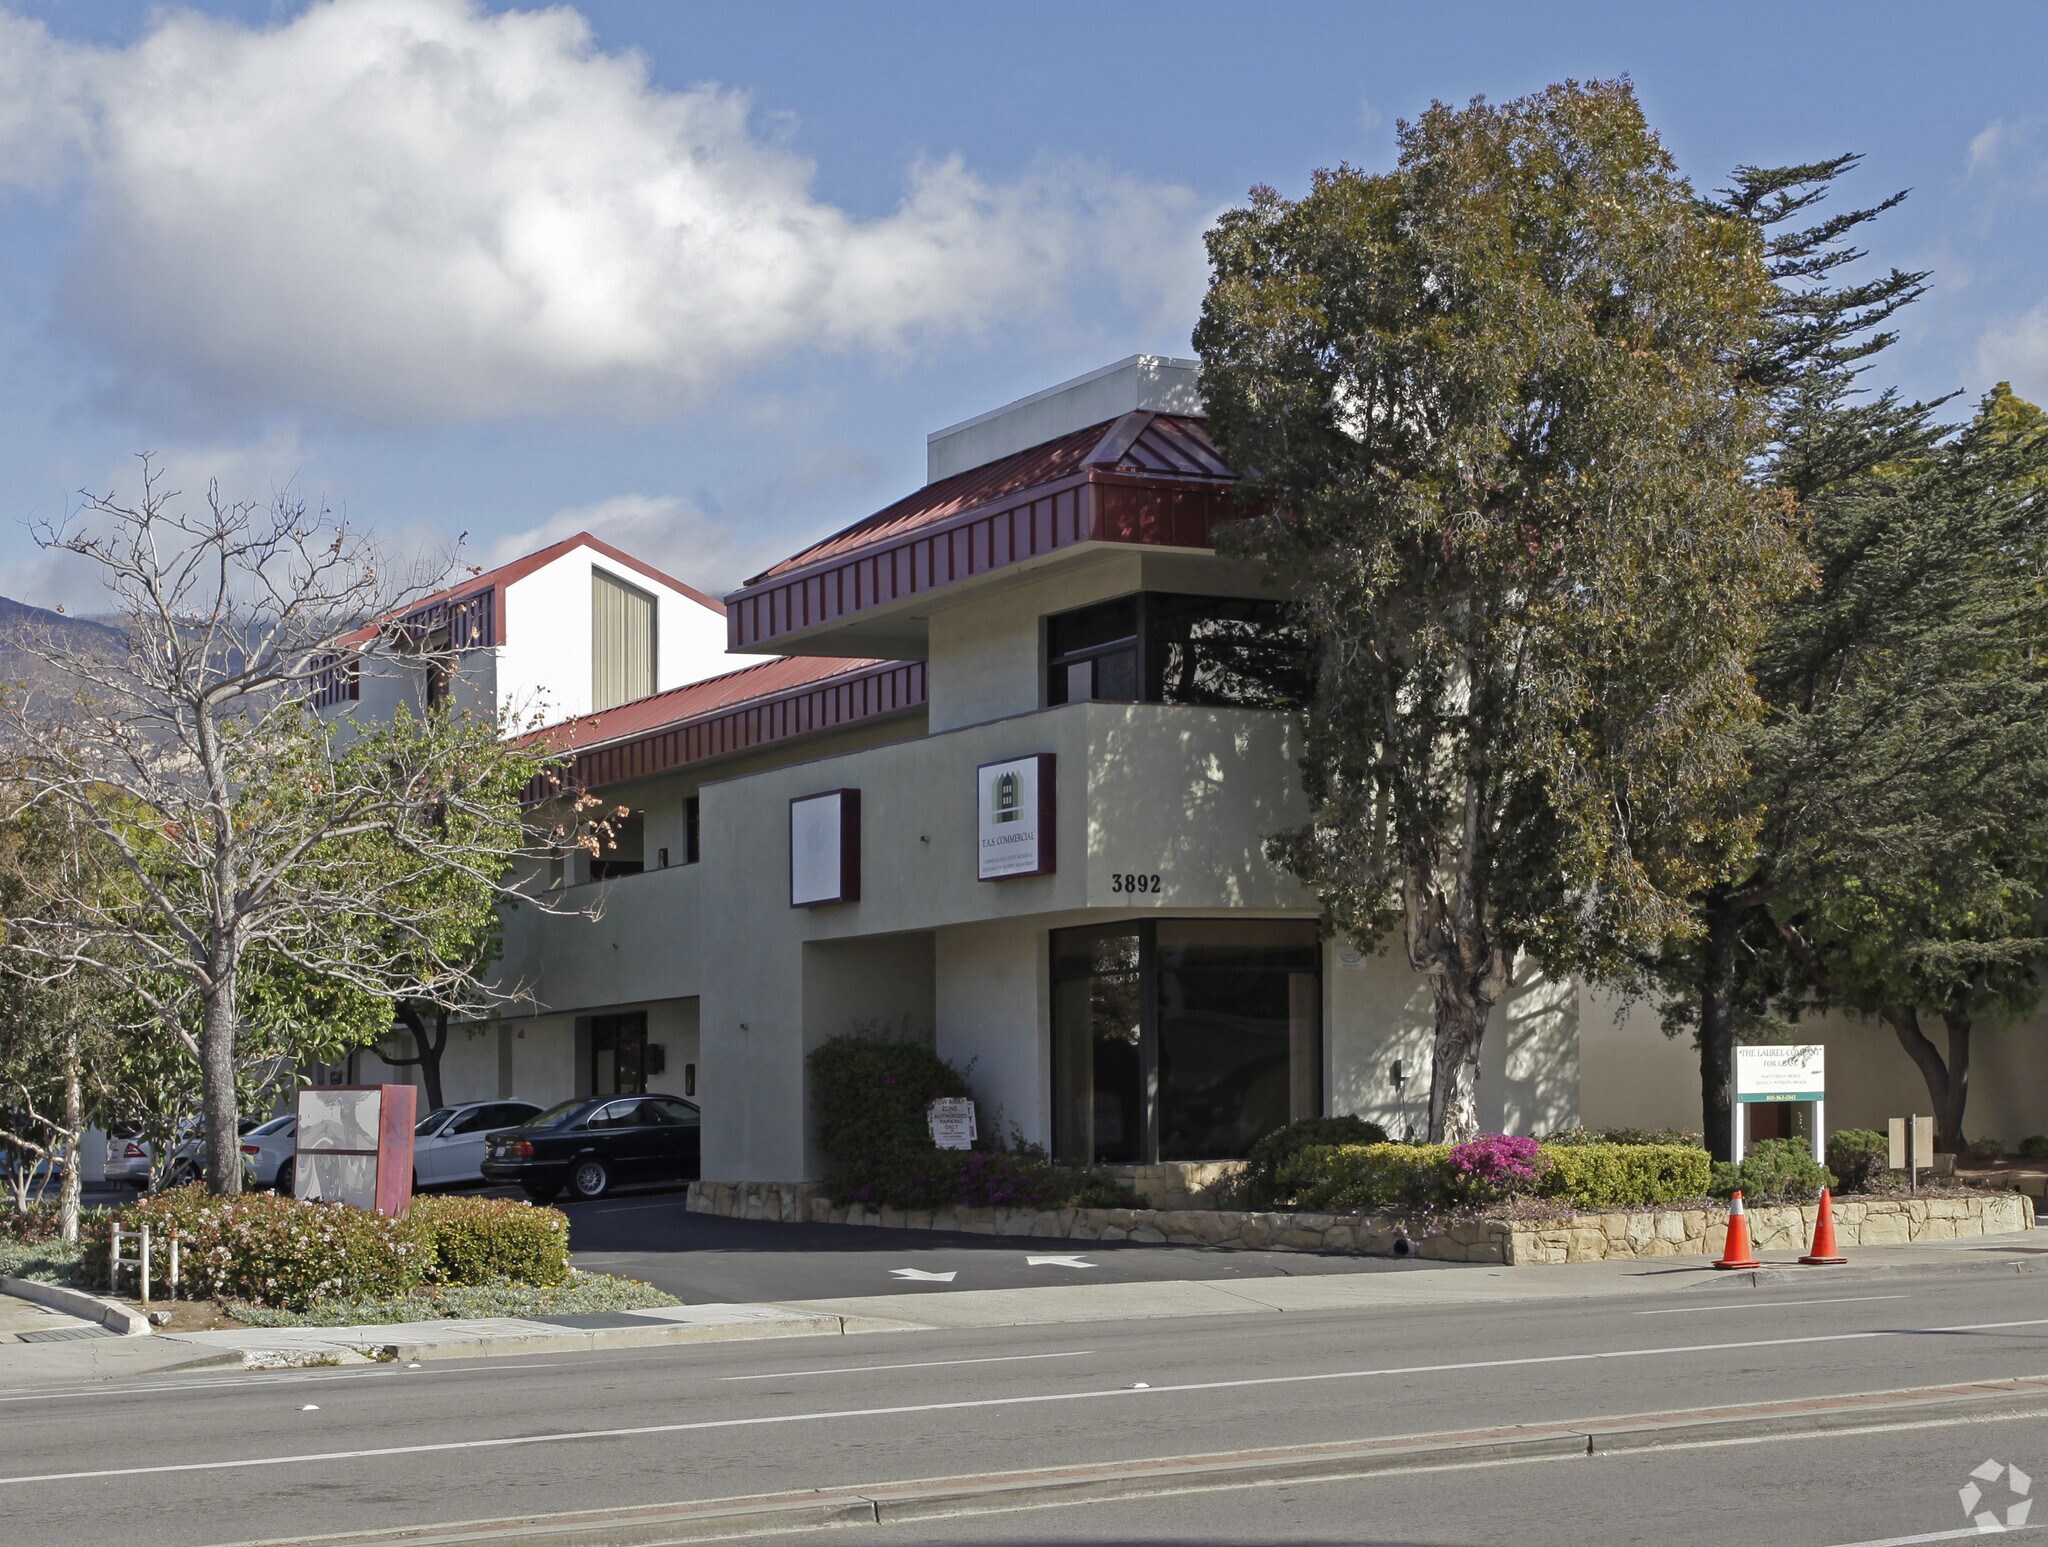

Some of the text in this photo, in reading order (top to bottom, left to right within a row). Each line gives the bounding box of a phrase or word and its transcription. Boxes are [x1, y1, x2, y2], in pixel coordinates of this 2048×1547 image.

[996, 831, 1035, 846] COMMERCIAL
[1112, 873, 1161, 893] 3892
[1741, 1049, 1756, 1057] THE
[1757, 1048, 1785, 1057] LAUREL
